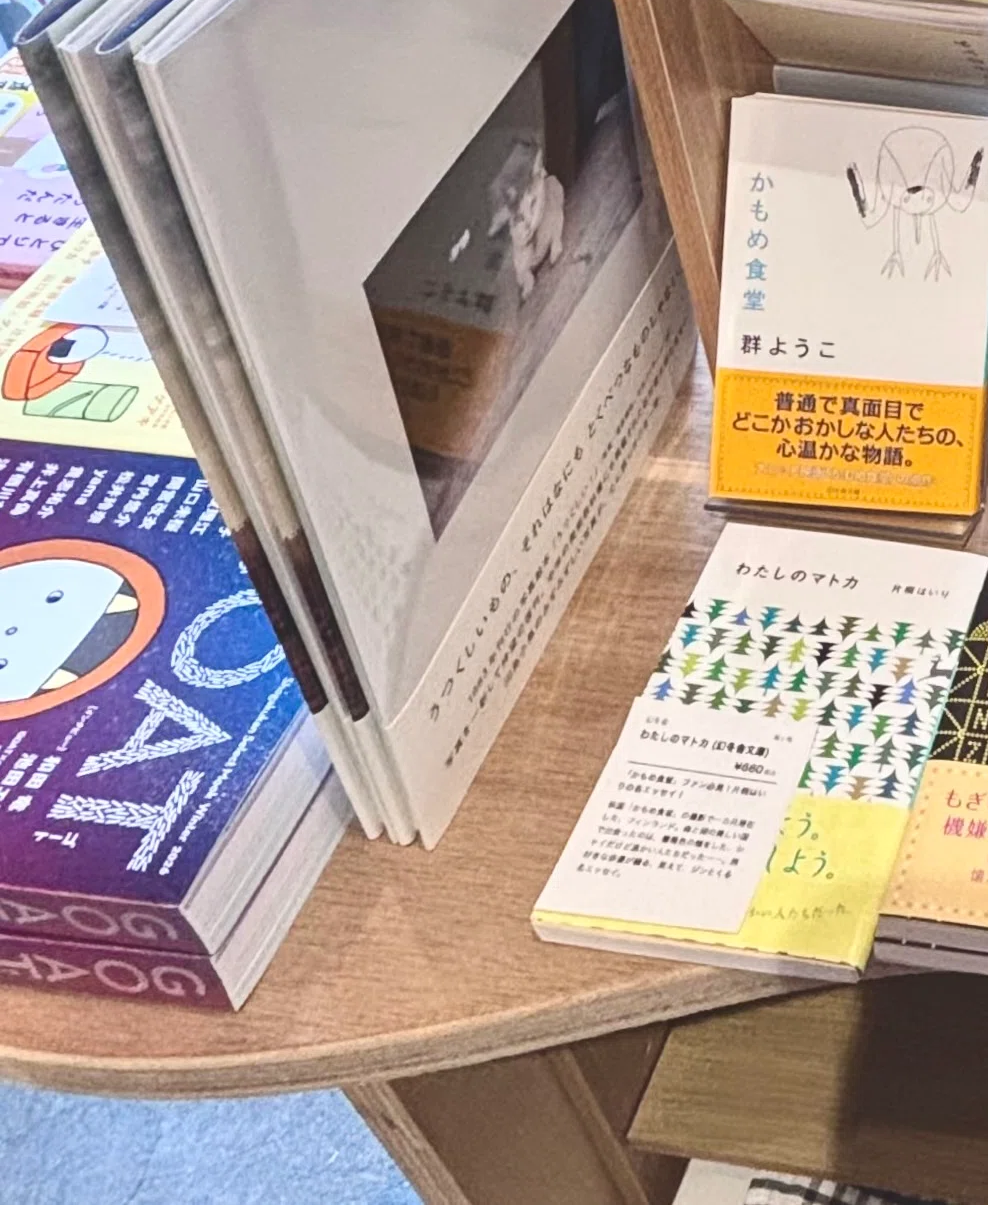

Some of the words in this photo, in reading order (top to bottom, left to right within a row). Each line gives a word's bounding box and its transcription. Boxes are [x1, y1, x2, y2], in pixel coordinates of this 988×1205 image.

[741, 171, 775, 313] かもめ食堂
[740, 334, 837, 359] 群ようこ
[773, 391, 925, 421] 普通で真面目で
[731, 412, 965, 448] どこかおかしな人たちの、
[775, 438, 913, 468] 心温かな物語。
[72, 468, 109, 506] yama
[735, 561, 860, 591] わたしのマトカ
[639, 728, 709, 750] わたしのマトカ
[177, 799, 210, 842] Winter
